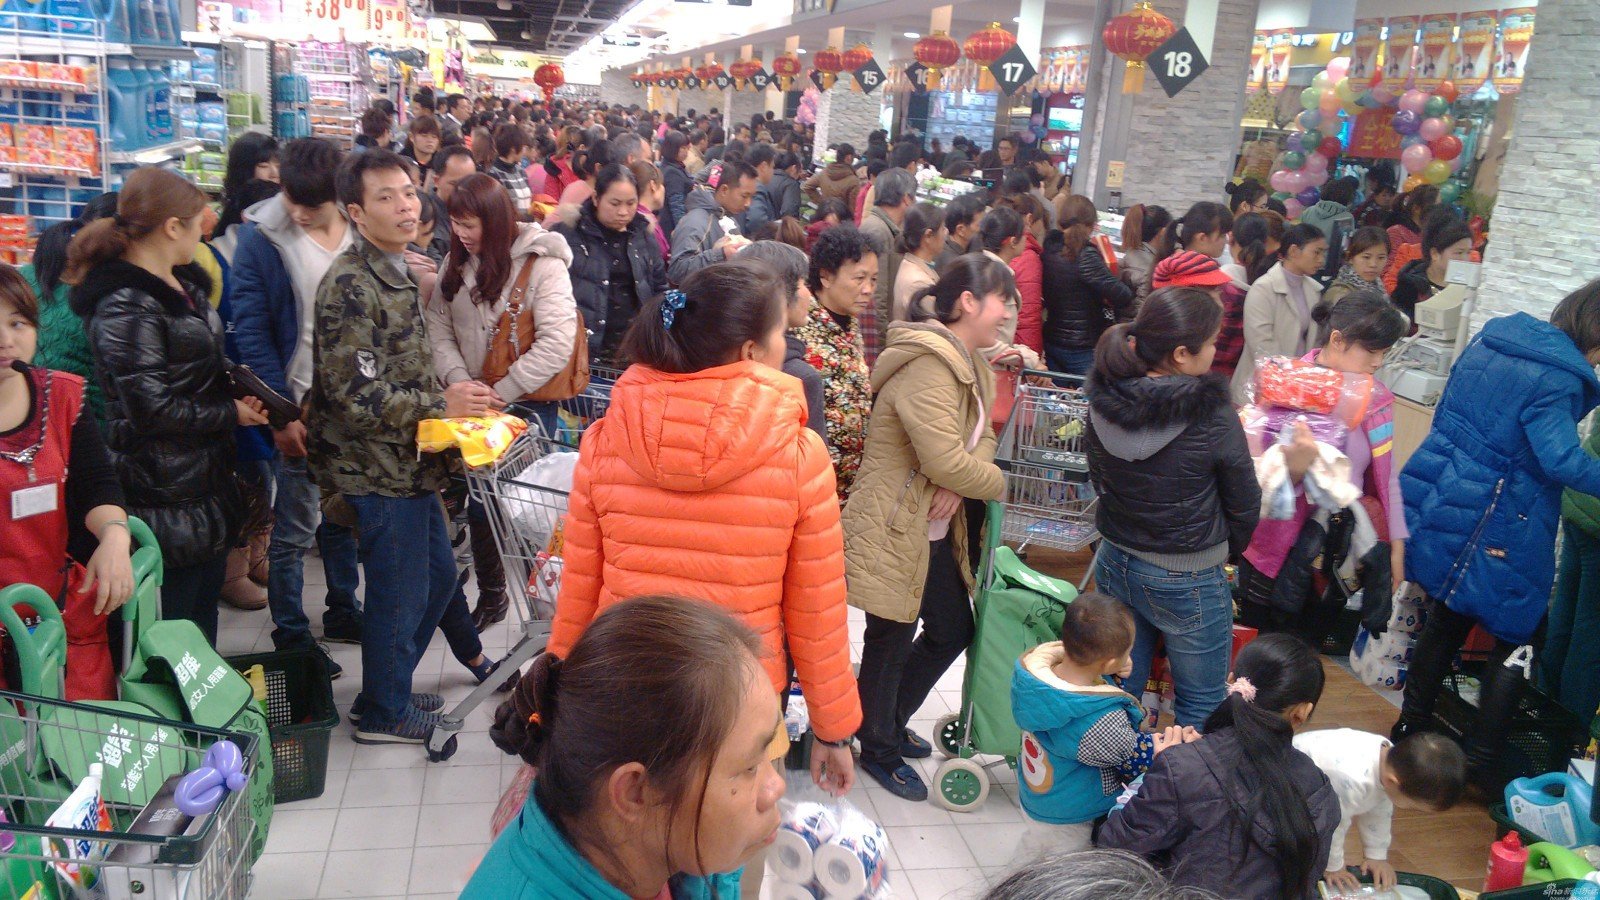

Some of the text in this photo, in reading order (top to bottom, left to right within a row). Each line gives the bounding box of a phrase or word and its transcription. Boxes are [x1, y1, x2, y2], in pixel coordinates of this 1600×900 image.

[1002, 62, 1024, 82] 17
[1164, 51, 1192, 77] 18
[717, 76, 728, 86] 10
[754, 75, 767, 86] 12
[862, 70, 878, 86] 15
[174, 650, 201, 687] 超能
[1503, 644, 1534, 680] A
